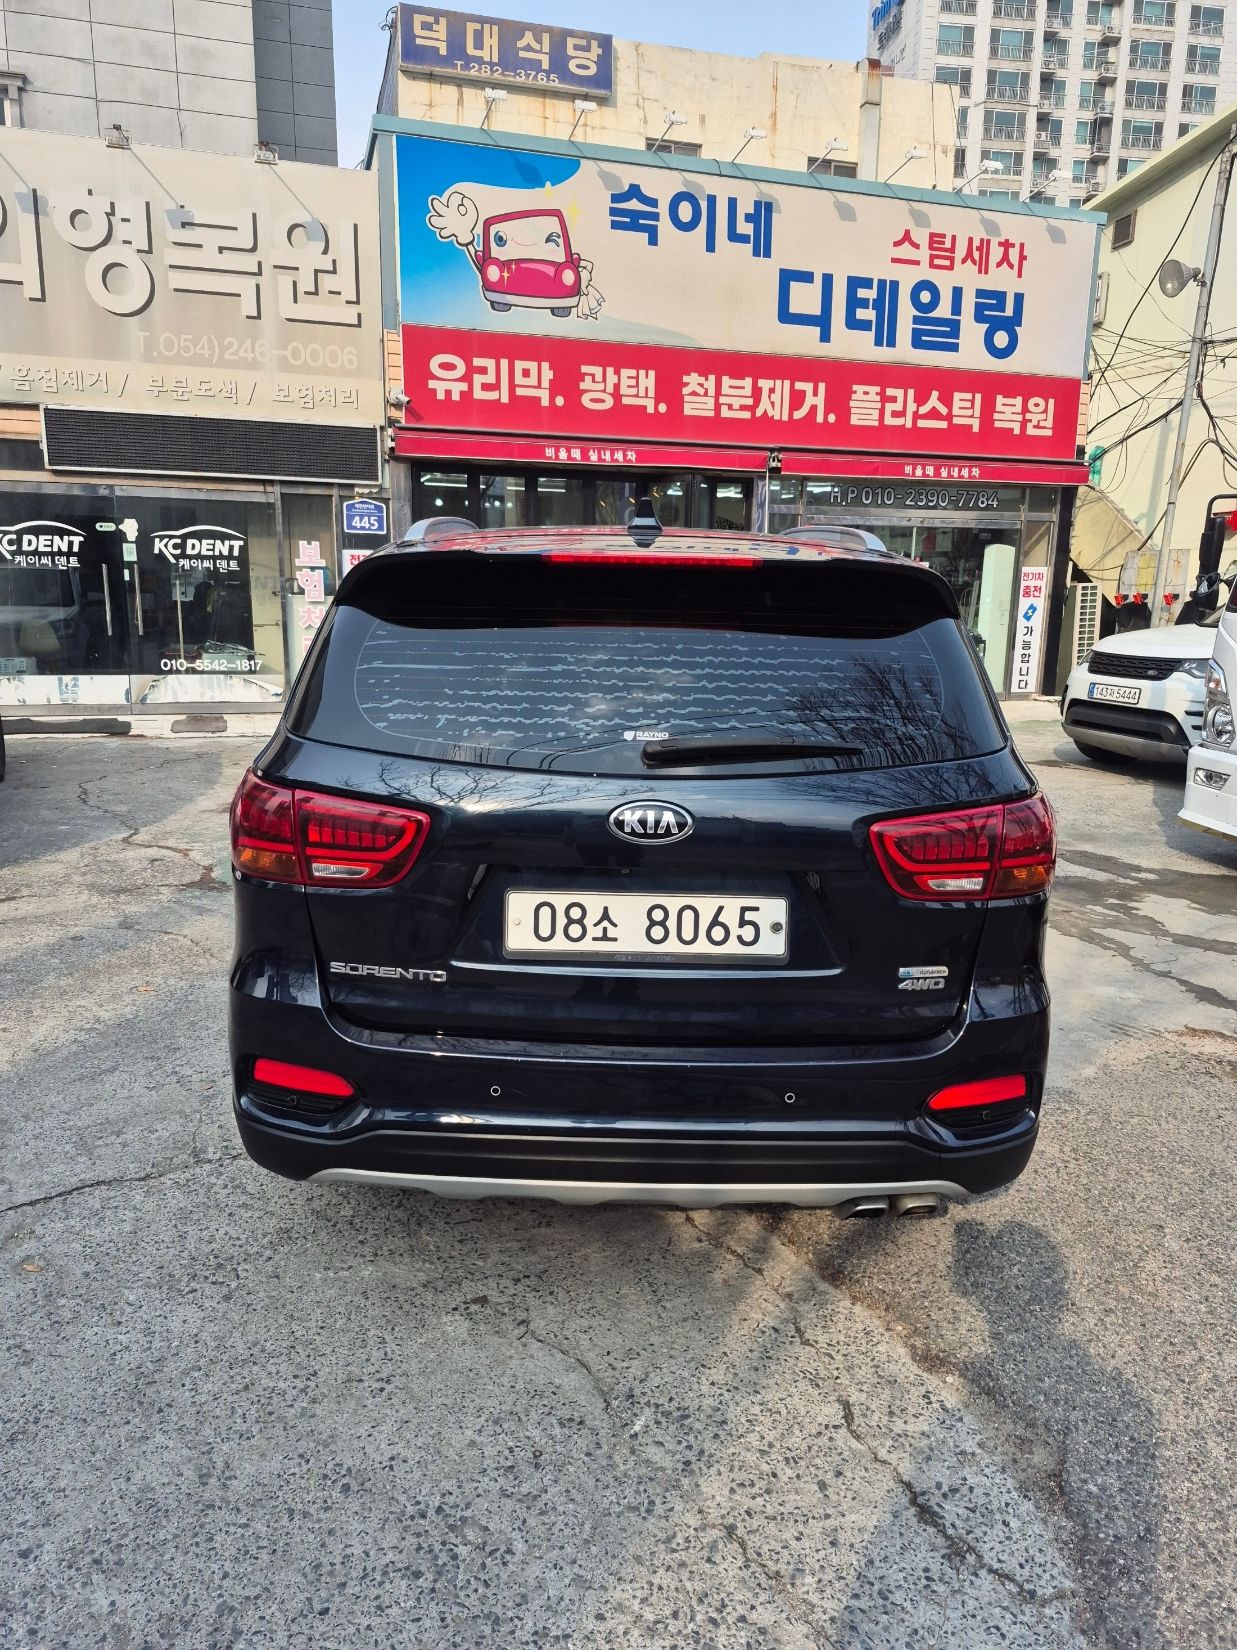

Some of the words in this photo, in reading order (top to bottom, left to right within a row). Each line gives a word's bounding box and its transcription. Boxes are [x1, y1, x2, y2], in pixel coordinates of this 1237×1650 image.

[412, 13, 603, 77] 덕대식당
[453, 60, 560, 86] T.282-3765
[608, 183, 773, 259] 숙이네
[890, 228, 1028, 279] 스팀세차
[777, 267, 1025, 360] 디테일링
[136, 330, 359, 371] T.054)246-0006
[145, 374, 239, 404] 부분도색
[271, 384, 360, 410] 보험처리
[427, 353, 565, 408] 유리막.
[578, 364, 668, 414] 광택.
[681, 372, 837, 424] 철분제거.
[849, 384, 983, 433] 플라스틱
[992, 394, 1055, 437] 복원
[545, 446, 582, 461] 비올때
[588, 448, 637, 463] 실내세차
[904, 464, 935, 477] 비올때
[939, 466, 981, 479] 실내세차
[861, 487, 999, 509] 010-2390-7784
[351, 515, 379, 530] 445
[22, 534, 85, 553] DENT
[153, 537, 182, 564] KC
[186, 538, 244, 557] DENT
[14, 554, 52, 568] 케이씨
[54, 555, 81, 570] 덴트
[178, 558, 214, 571] 케이씨
[216, 559, 241, 573] 덴트
[1022, 571, 1044, 582] 전기차
[1022, 585, 1042, 598] 충전
[160, 658, 263, 672] 010-5542-1817
[1017, 625, 1034, 690] 가능합니다
[1115, 688, 1137, 701] 5444
[636, 731, 669, 739] RAYNO
[623, 810, 679, 834] KIA
[533, 901, 618, 943] 08소
[645, 903, 761, 947] 8065
[330, 961, 447, 982] SORENTO
[898, 978, 946, 991] 4WD
